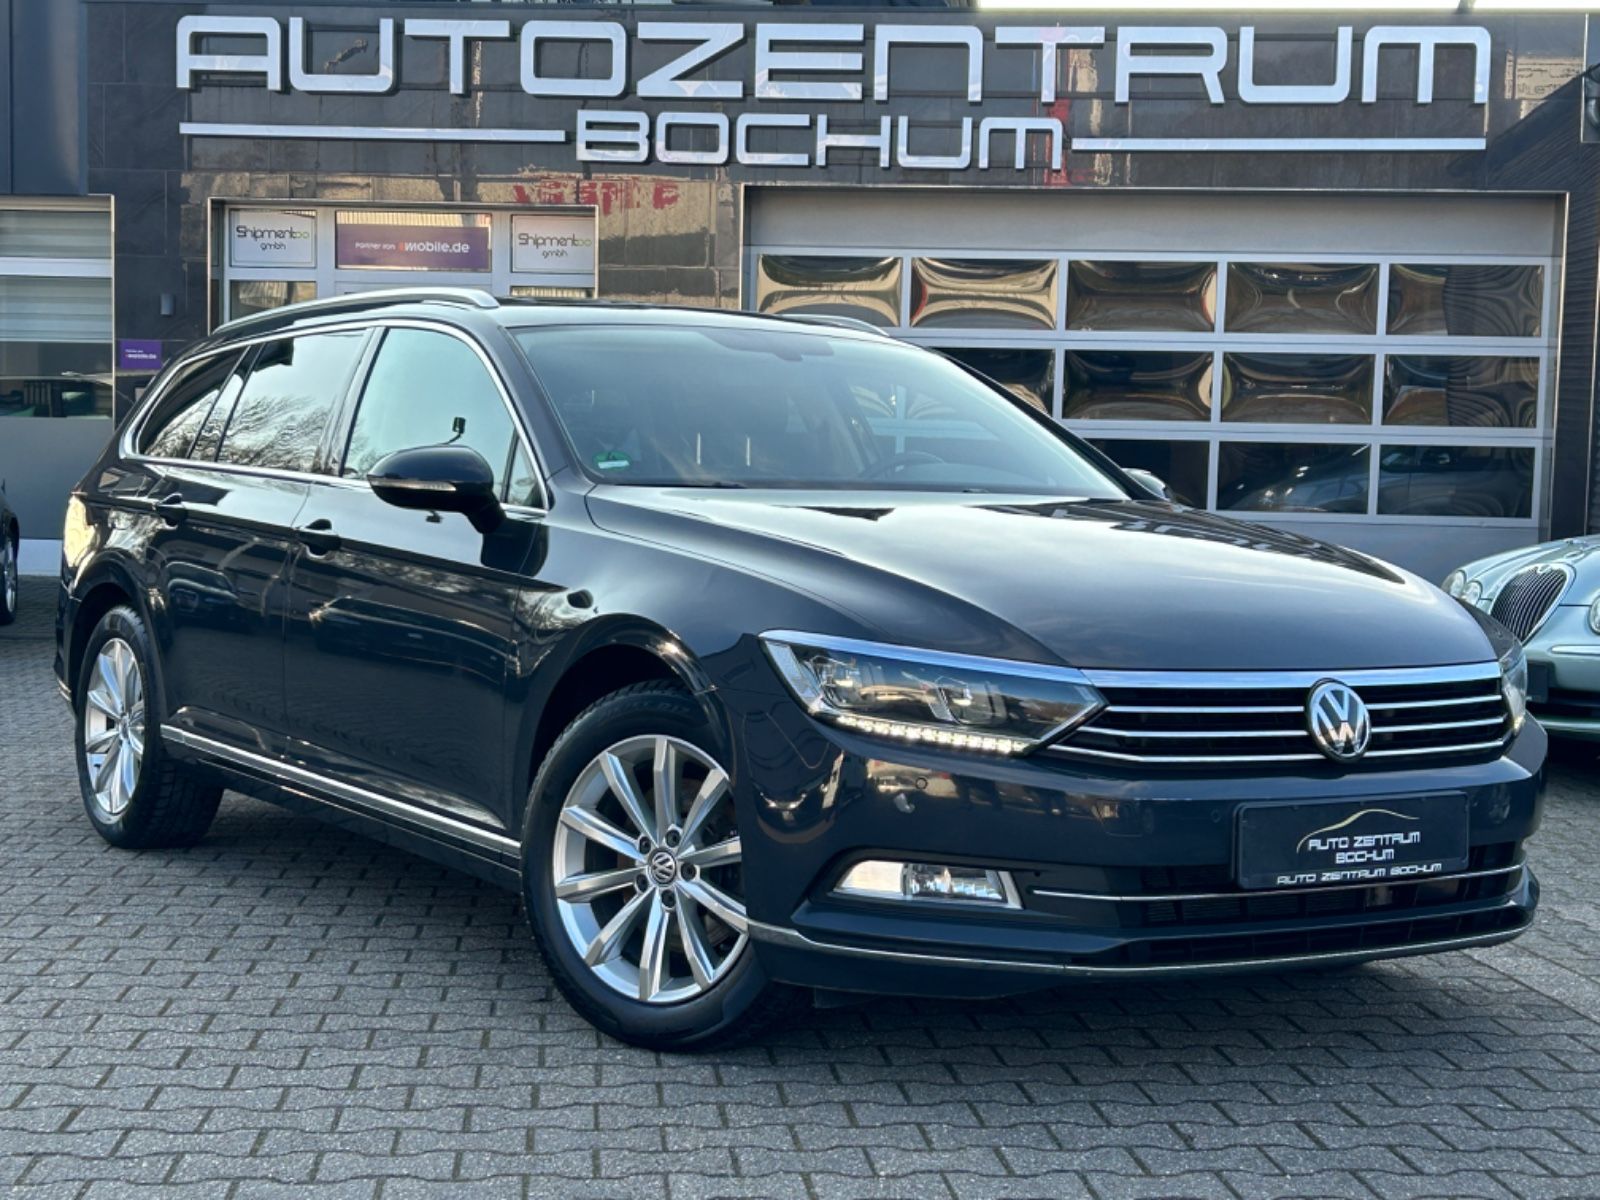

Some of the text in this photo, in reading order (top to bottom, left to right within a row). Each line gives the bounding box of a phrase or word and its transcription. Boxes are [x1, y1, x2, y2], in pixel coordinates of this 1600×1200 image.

[176, 15, 1491, 104] AUTOZENTRUM
[576, 109, 1063, 170] BOCHUM
[260, 242, 286, 251] gmbh
[404, 241, 470, 253] mobile.de
[542, 250, 568, 259] gmbh
[1308, 831, 1421, 851] AUTO ZENTRUM
[1335, 849, 1395, 864] BOCHUM
[1276, 863, 1442, 885] AUTO ZENTRUM BOCHUM
